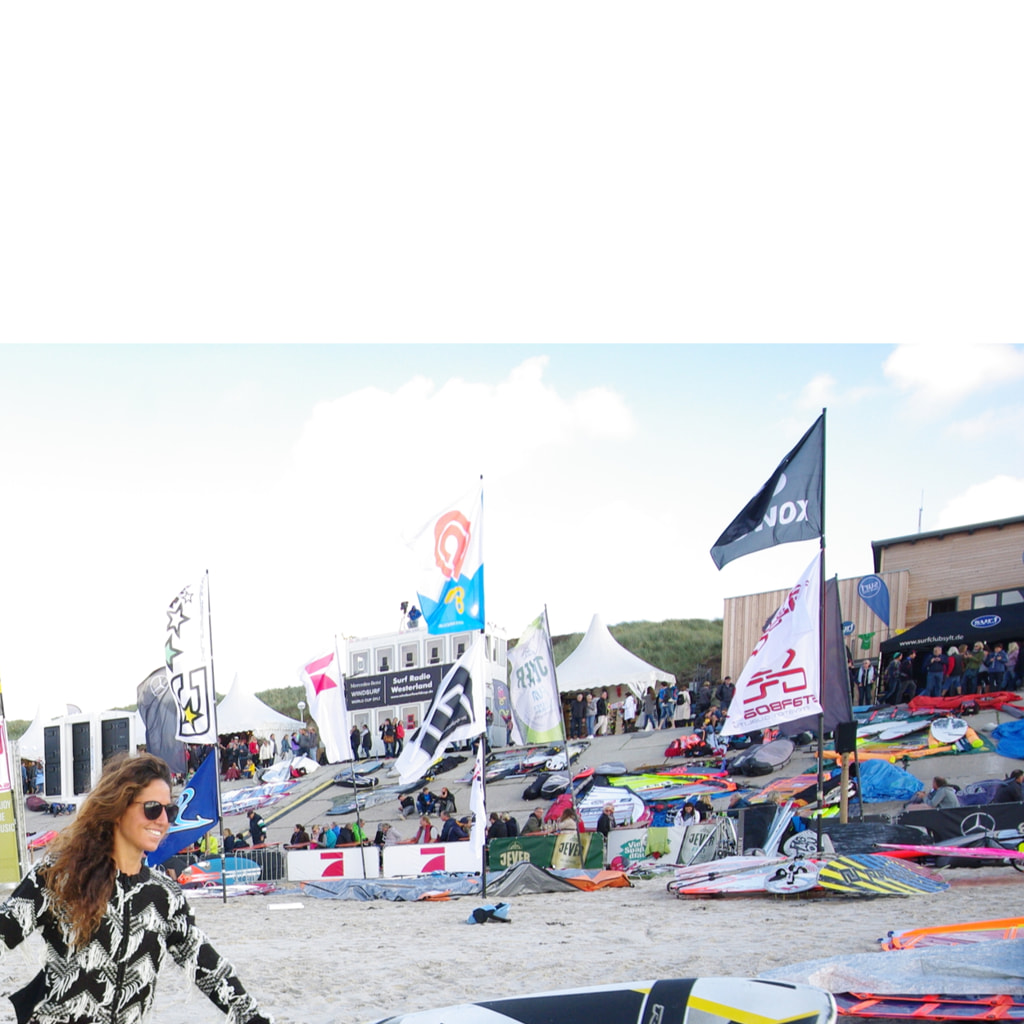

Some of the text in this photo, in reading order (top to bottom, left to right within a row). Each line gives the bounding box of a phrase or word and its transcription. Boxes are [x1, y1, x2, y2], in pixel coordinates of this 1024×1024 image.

[753, 499, 808, 533] NOX
[393, 673, 431, 685] Surf Radio
[391, 681, 433, 694] Westerland
[500, 851, 530, 866] JEVER
